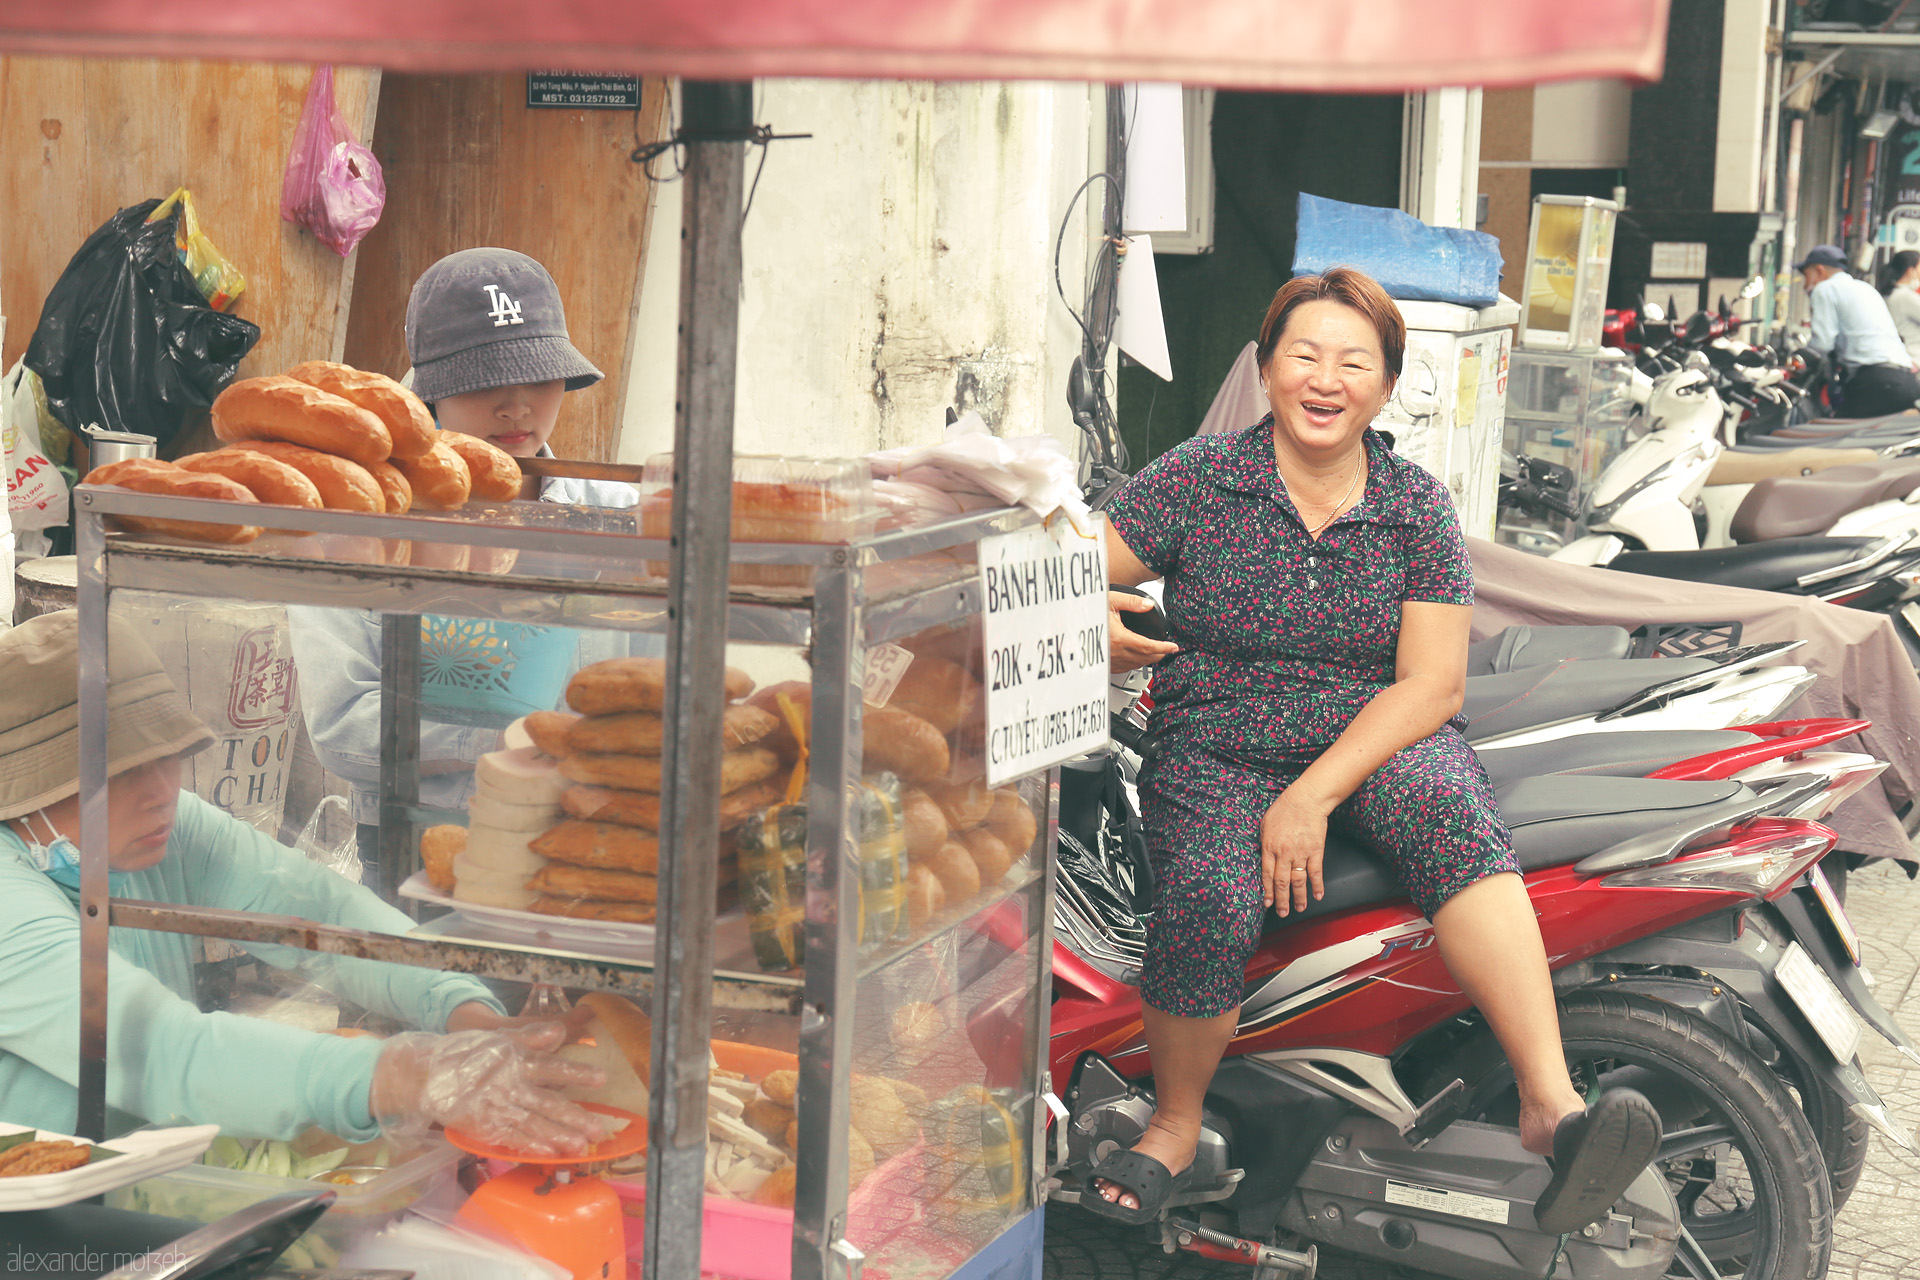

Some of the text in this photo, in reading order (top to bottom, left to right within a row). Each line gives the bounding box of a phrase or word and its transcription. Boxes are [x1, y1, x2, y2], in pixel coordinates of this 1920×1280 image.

[542, 94, 627, 104] MST: 0312571922
[483, 284, 525, 328] LA
[986, 547, 1039, 614] BÁNH
[1044, 538, 1066, 604] MÌ
[991, 642, 1022, 692] 20K
[1037, 632, 1066, 681] 25K
[1078, 623, 1105, 670] 30K
[1043, 696, 1107, 750] 0785.127.631
[213, 767, 282, 809] CHA
